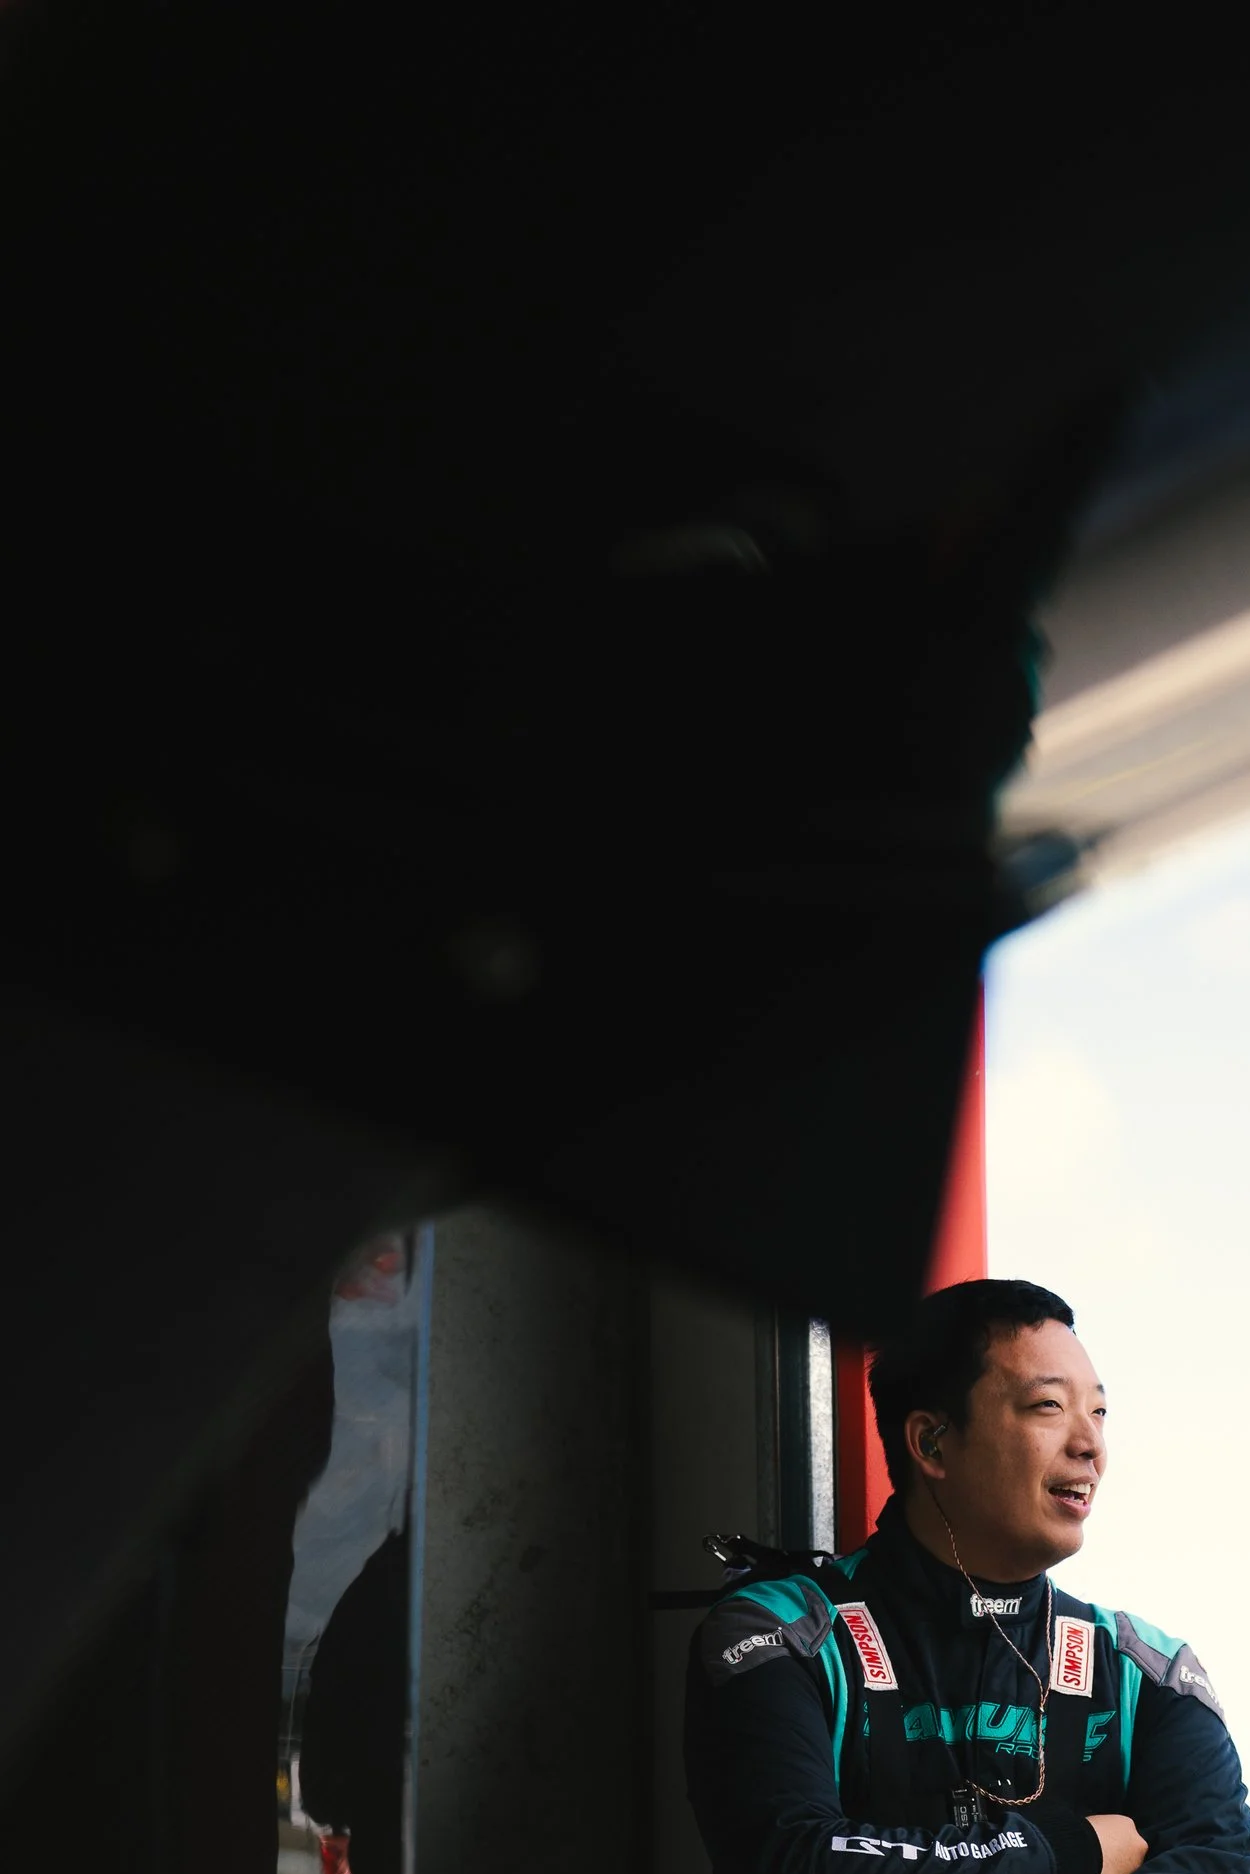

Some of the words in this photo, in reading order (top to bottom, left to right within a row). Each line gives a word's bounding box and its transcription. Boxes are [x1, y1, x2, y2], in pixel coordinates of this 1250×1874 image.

[970, 1594, 1021, 1617] freem
[722, 1628, 784, 1664] freem
[843, 1614, 887, 1680] SIMPSON
[1063, 1626, 1084, 1686] SIMPSON
[934, 1841, 969, 1861] AUTO
[970, 1831, 1028, 1859] GARAGE
